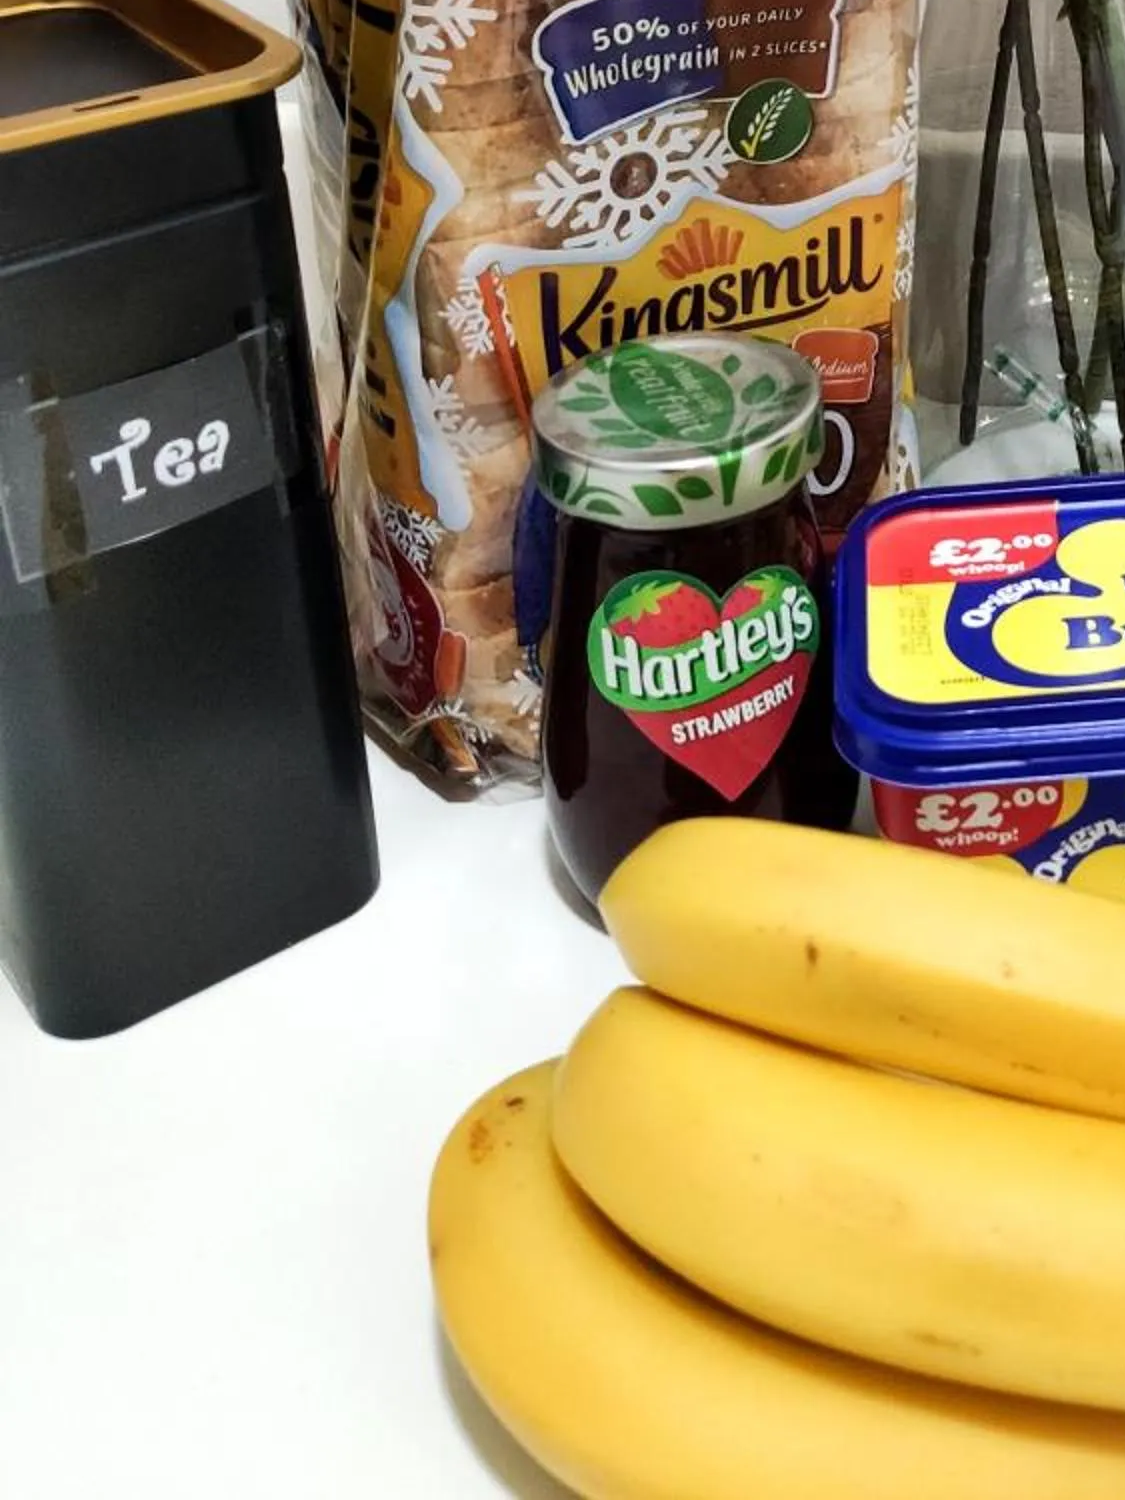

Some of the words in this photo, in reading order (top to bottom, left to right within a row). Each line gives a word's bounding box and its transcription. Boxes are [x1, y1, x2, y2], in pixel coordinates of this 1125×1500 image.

[592, 16, 671, 51] 50%
[677, 21, 699, 36] OF
[705, 12, 750, 32] YOUR
[756, 7, 803, 24] DAILY
[563, 45, 721, 99] Wholegrain
[729, 47, 746, 61] IN
[751, 45, 760, 57] 2
[89, 417, 231, 503] Tea
[929, 532, 1053, 567] £2.00
[947, 560, 1026, 577] whoop!
[601, 586, 813, 699] Hartley's
[671, 675, 795, 746] STRAWBERRY
[915, 784, 1059, 833] £2.00
[935, 828, 1021, 849] whoop!
